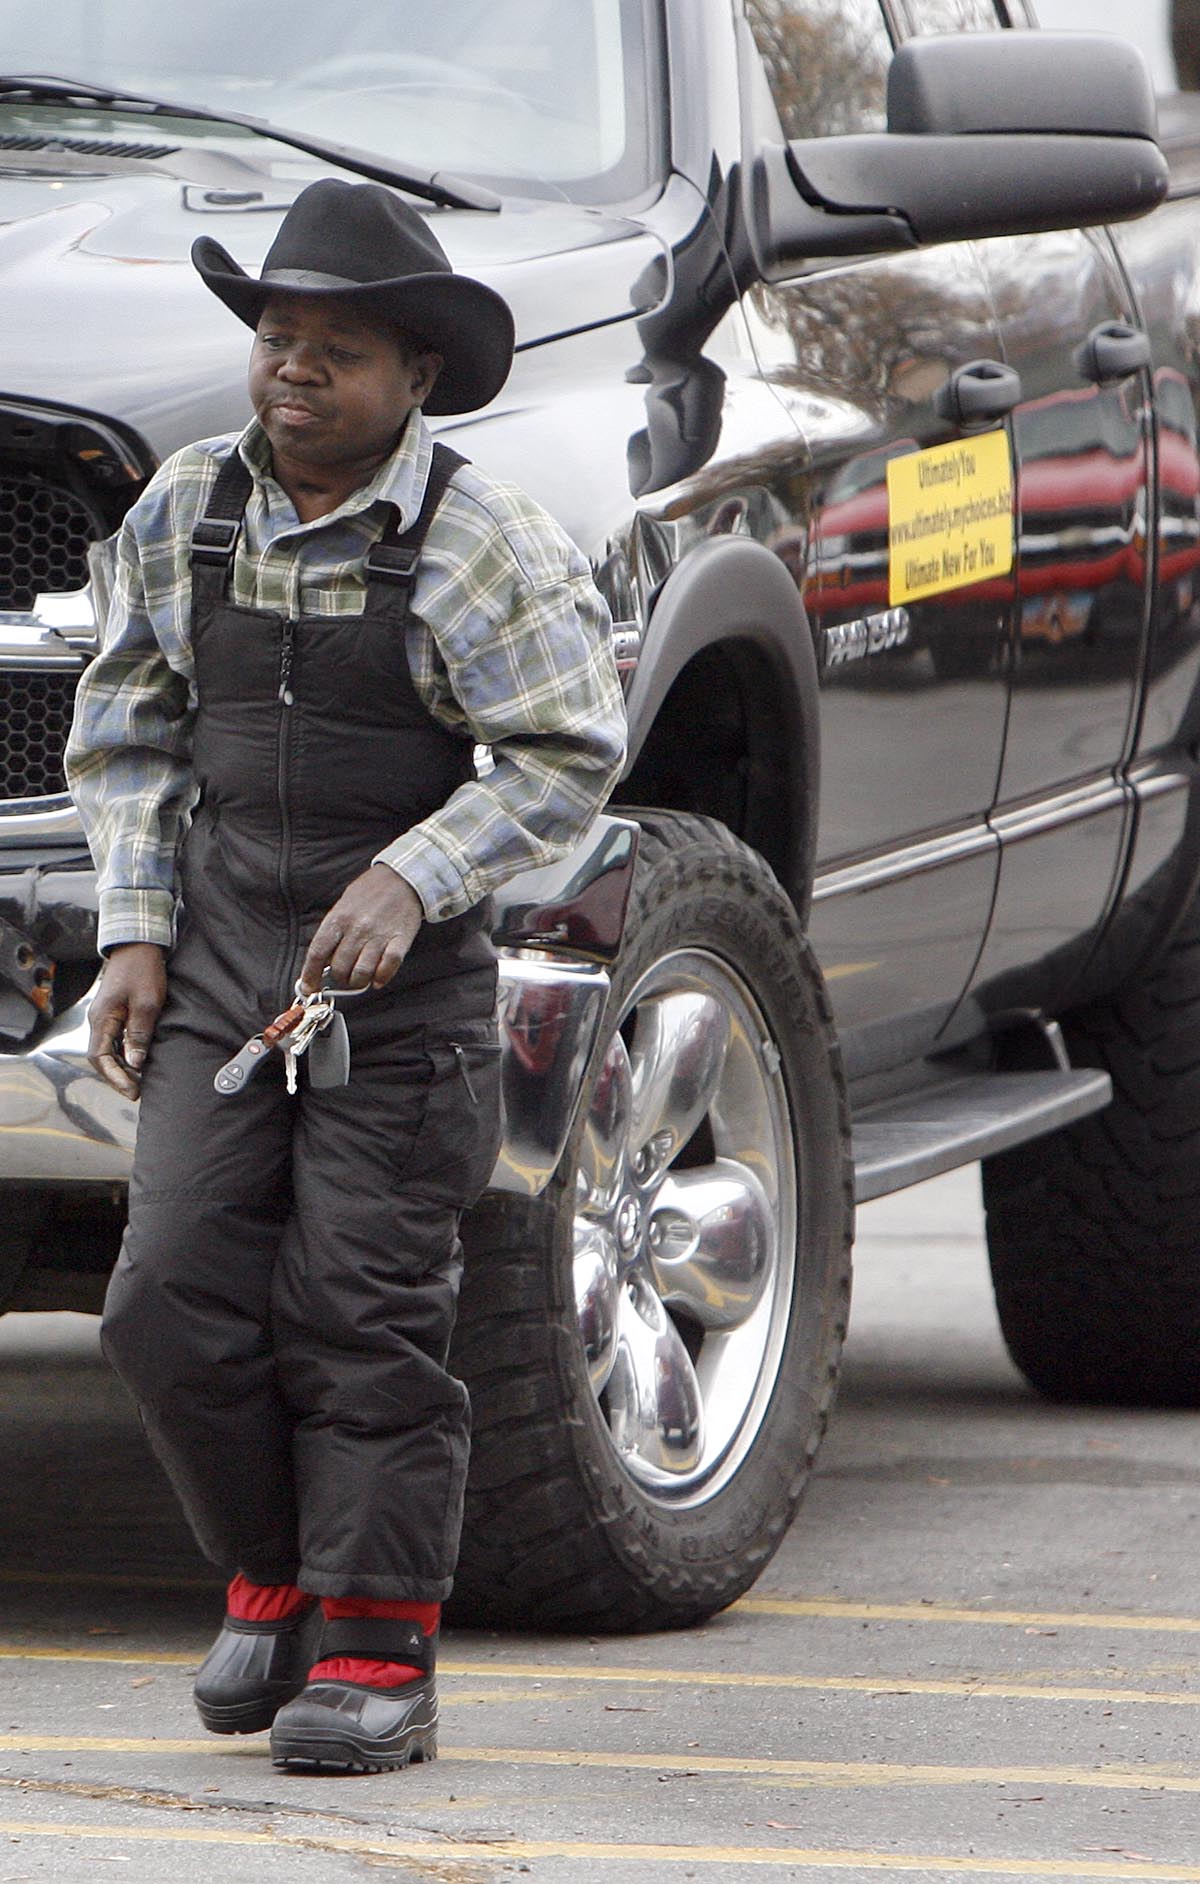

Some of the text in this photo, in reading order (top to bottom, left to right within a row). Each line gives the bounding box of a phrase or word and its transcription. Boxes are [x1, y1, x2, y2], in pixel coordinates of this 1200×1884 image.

[905, 536, 995, 592] Ultimate New For You
